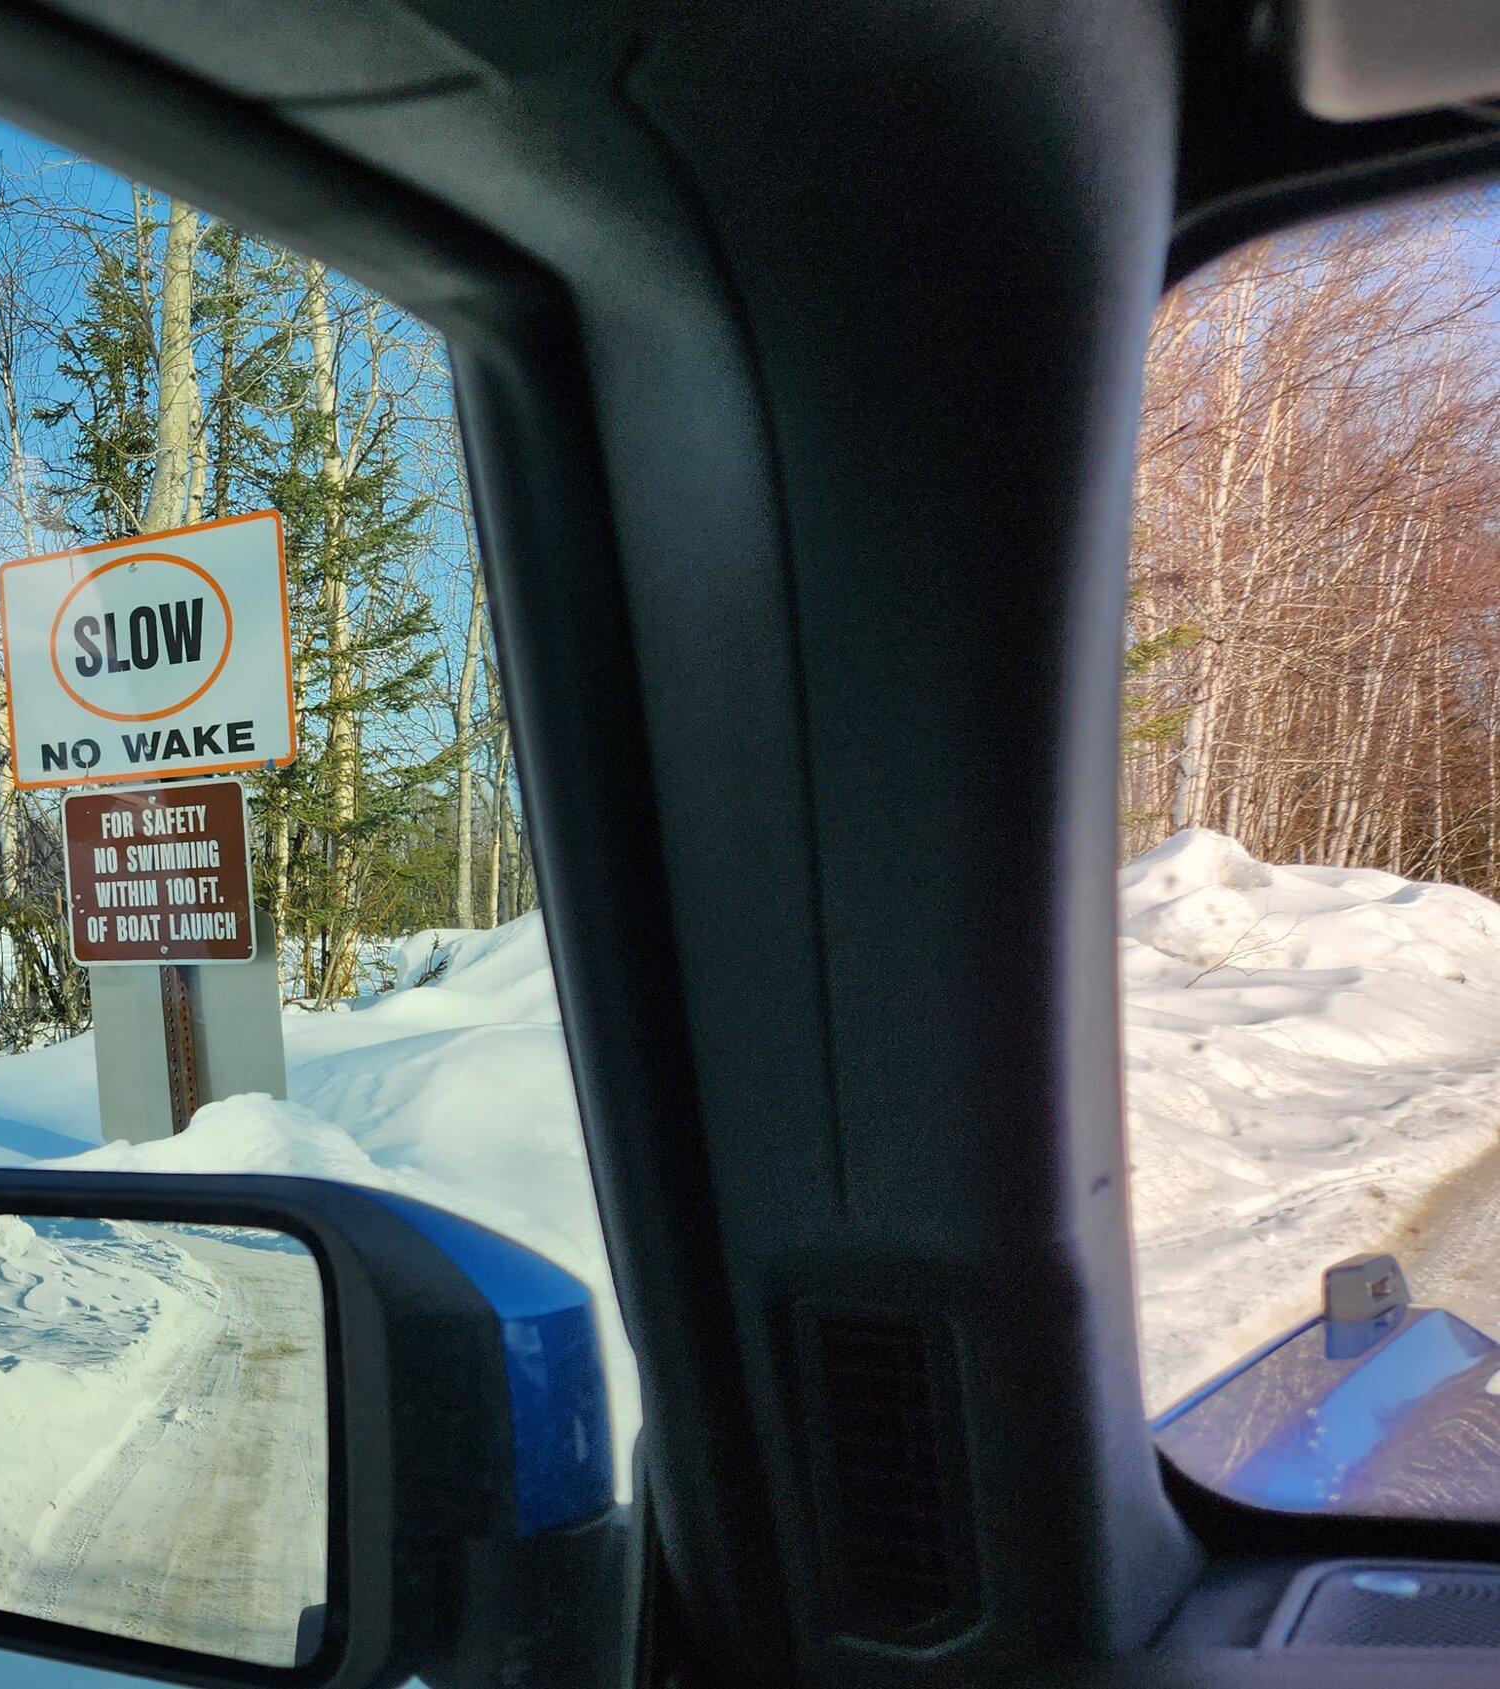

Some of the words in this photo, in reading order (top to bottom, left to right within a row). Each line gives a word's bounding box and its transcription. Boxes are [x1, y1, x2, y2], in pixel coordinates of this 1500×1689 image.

[74, 598, 203, 677] SLOW
[41, 738, 101, 772] NO
[121, 720, 255, 763] WAKE
[101, 811, 135, 839] FOR
[142, 805, 207, 837] SAFETY
[94, 846, 118, 874] NO
[126, 839, 220, 873] SWIMMING
[95, 879, 159, 908] WITHIN
[87, 916, 108, 943] OF
[116, 914, 161, 942] BOAT
[169, 911, 237, 941] LAUNCH
